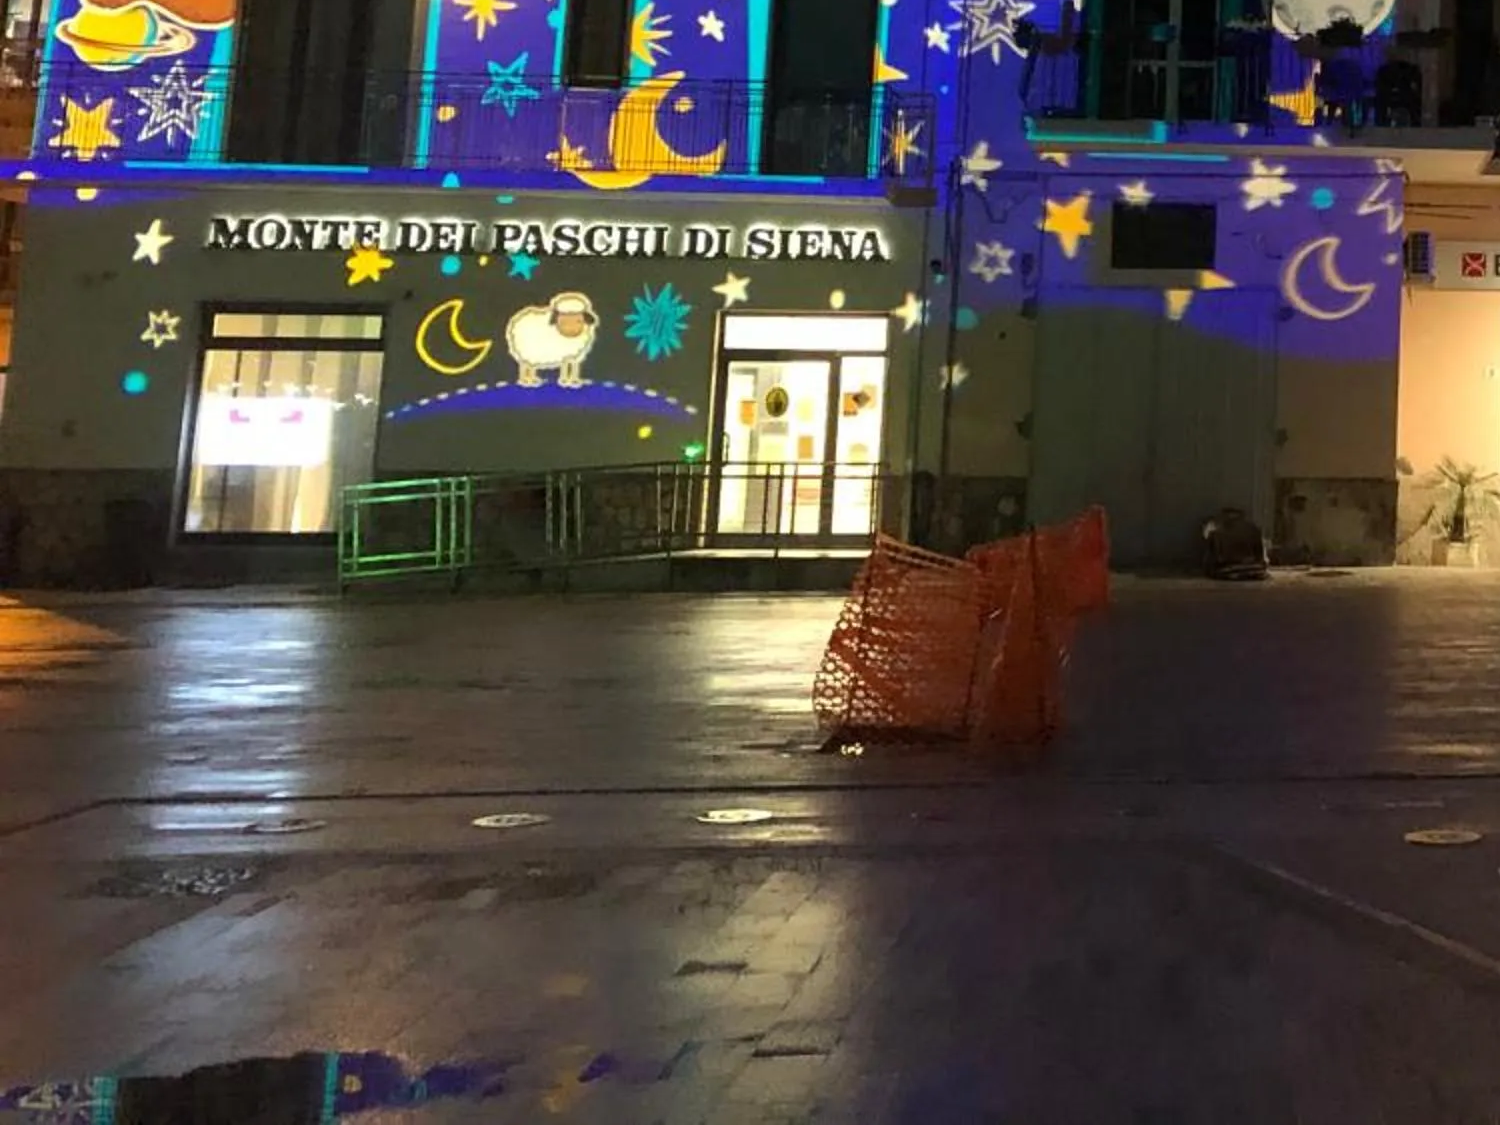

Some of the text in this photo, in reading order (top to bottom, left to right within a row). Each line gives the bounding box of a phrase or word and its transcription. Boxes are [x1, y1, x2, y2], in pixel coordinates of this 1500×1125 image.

[206, 217, 890, 262] MONTE DEI PASCHI DI SIENA
